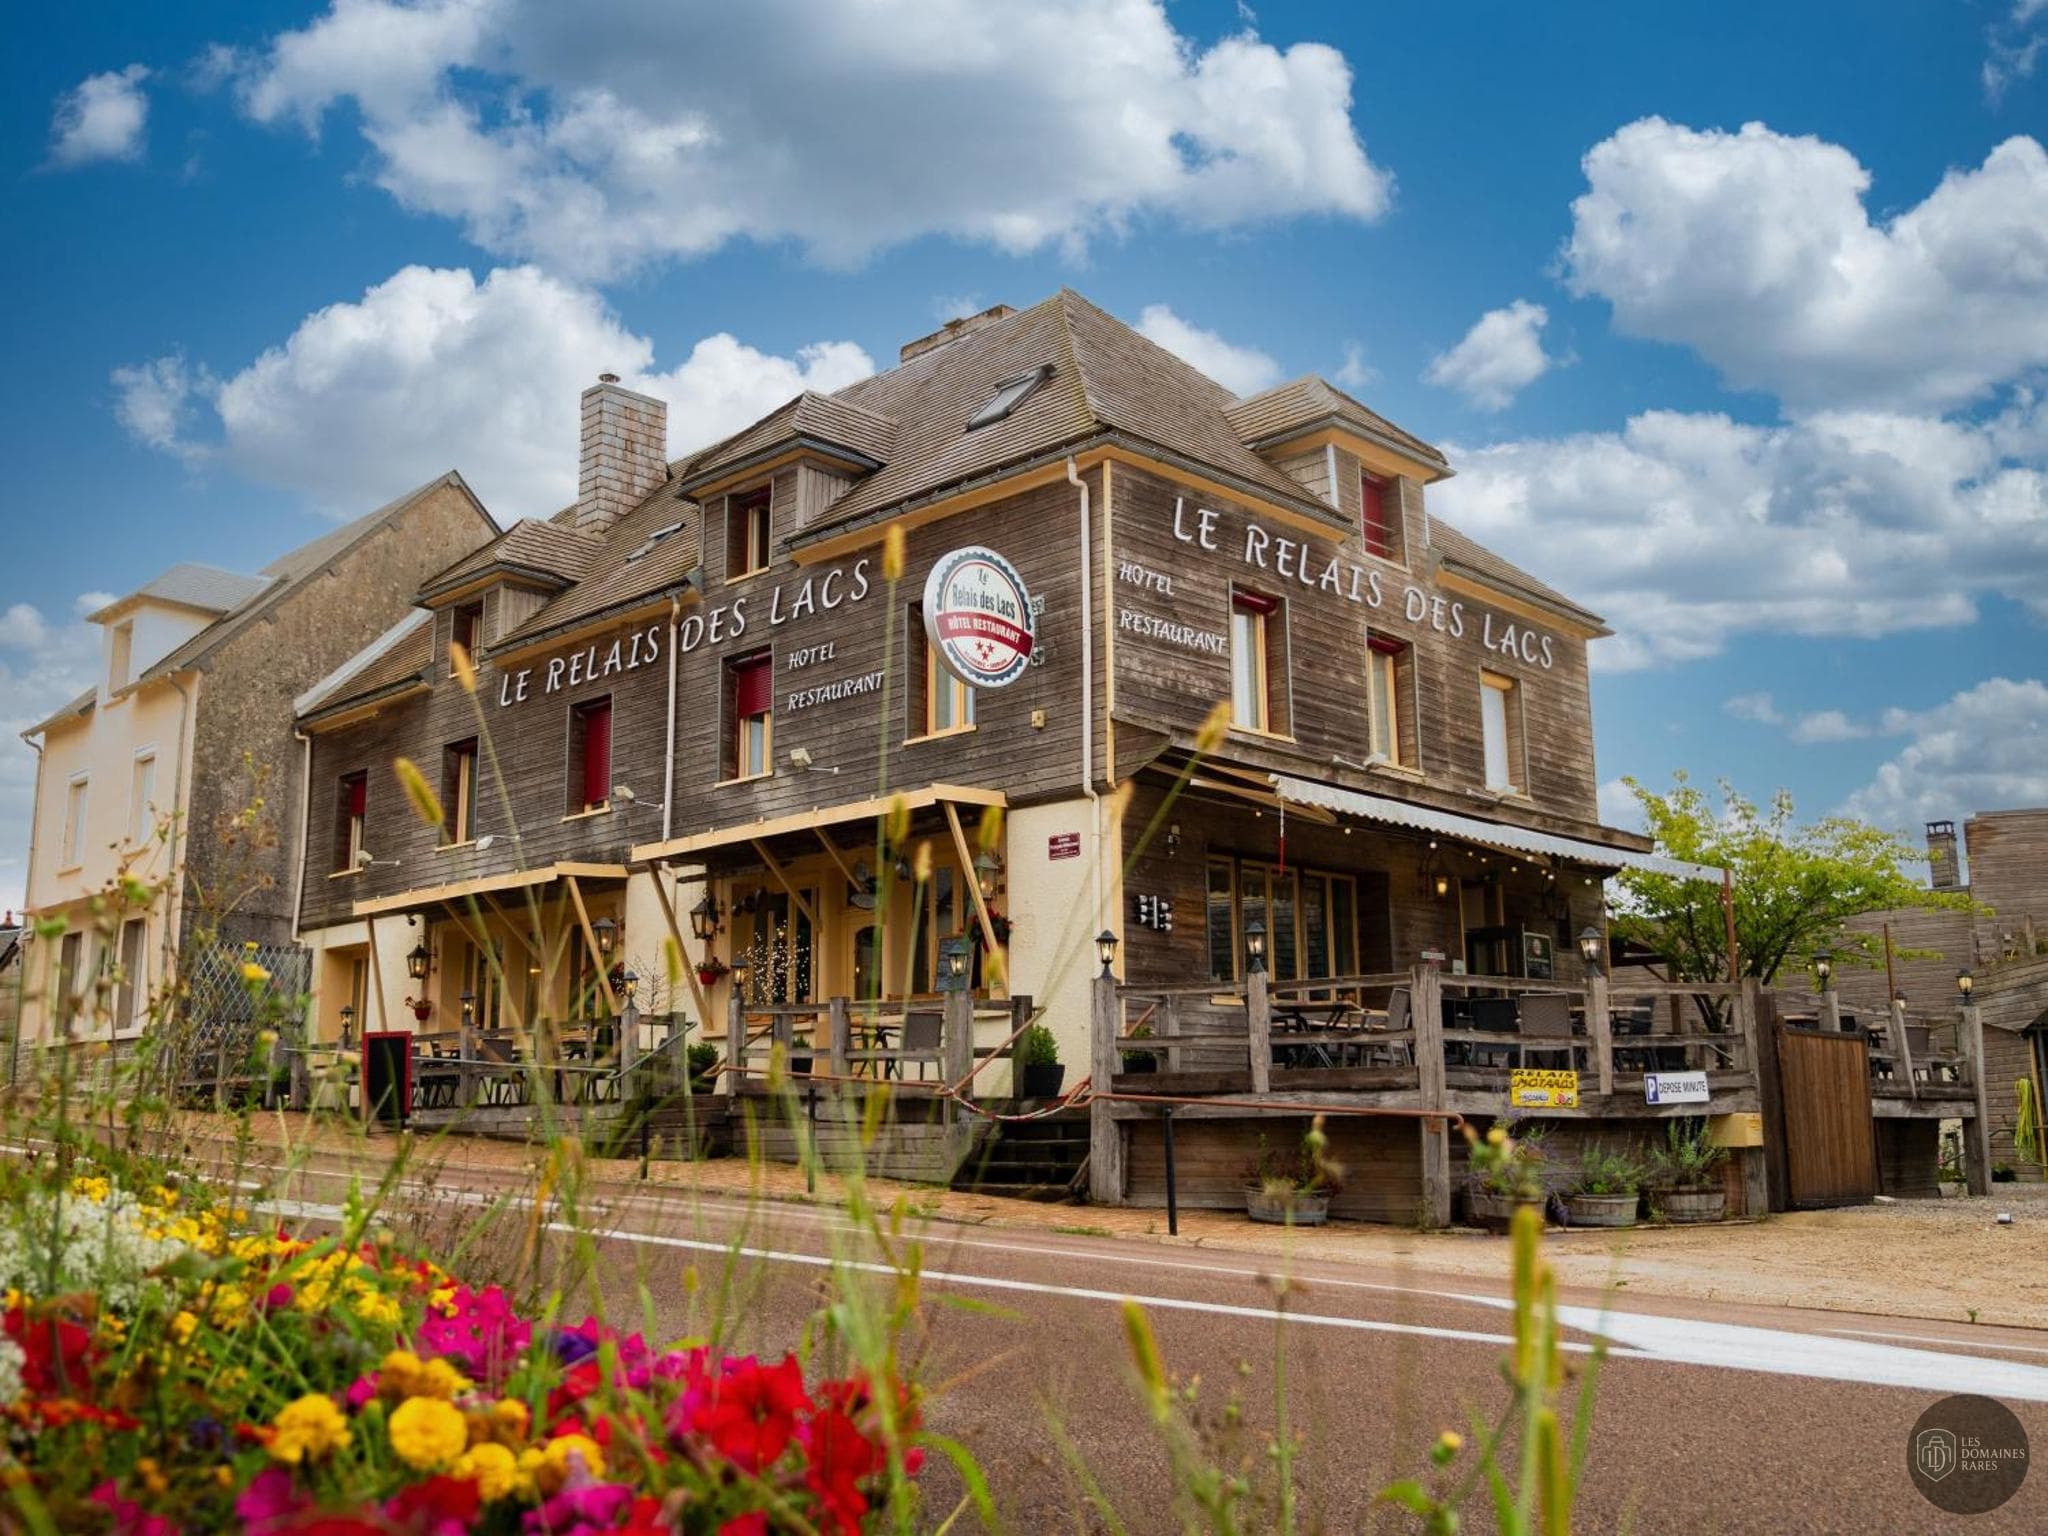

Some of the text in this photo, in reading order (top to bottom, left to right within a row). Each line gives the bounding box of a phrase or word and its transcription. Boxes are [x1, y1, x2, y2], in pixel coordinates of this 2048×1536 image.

[952, 584, 977, 607] Relais
[979, 590, 995, 611] des
[997, 594, 1016, 620] Lacs
[1173, 497, 1552, 669] LE RELAIS DES LACS
[500, 559, 869, 706] LE RELAIS DES LACS
[973, 617, 1021, 644] RESTAURANT
[1119, 610, 1227, 654] RESTAURANT
[788, 641, 836, 670] HOTEL
[788, 672, 884, 712] RESTAURANT
[1646, 1079, 1658, 1100] P
[1683, 1080, 1707, 1092] MINUTE
